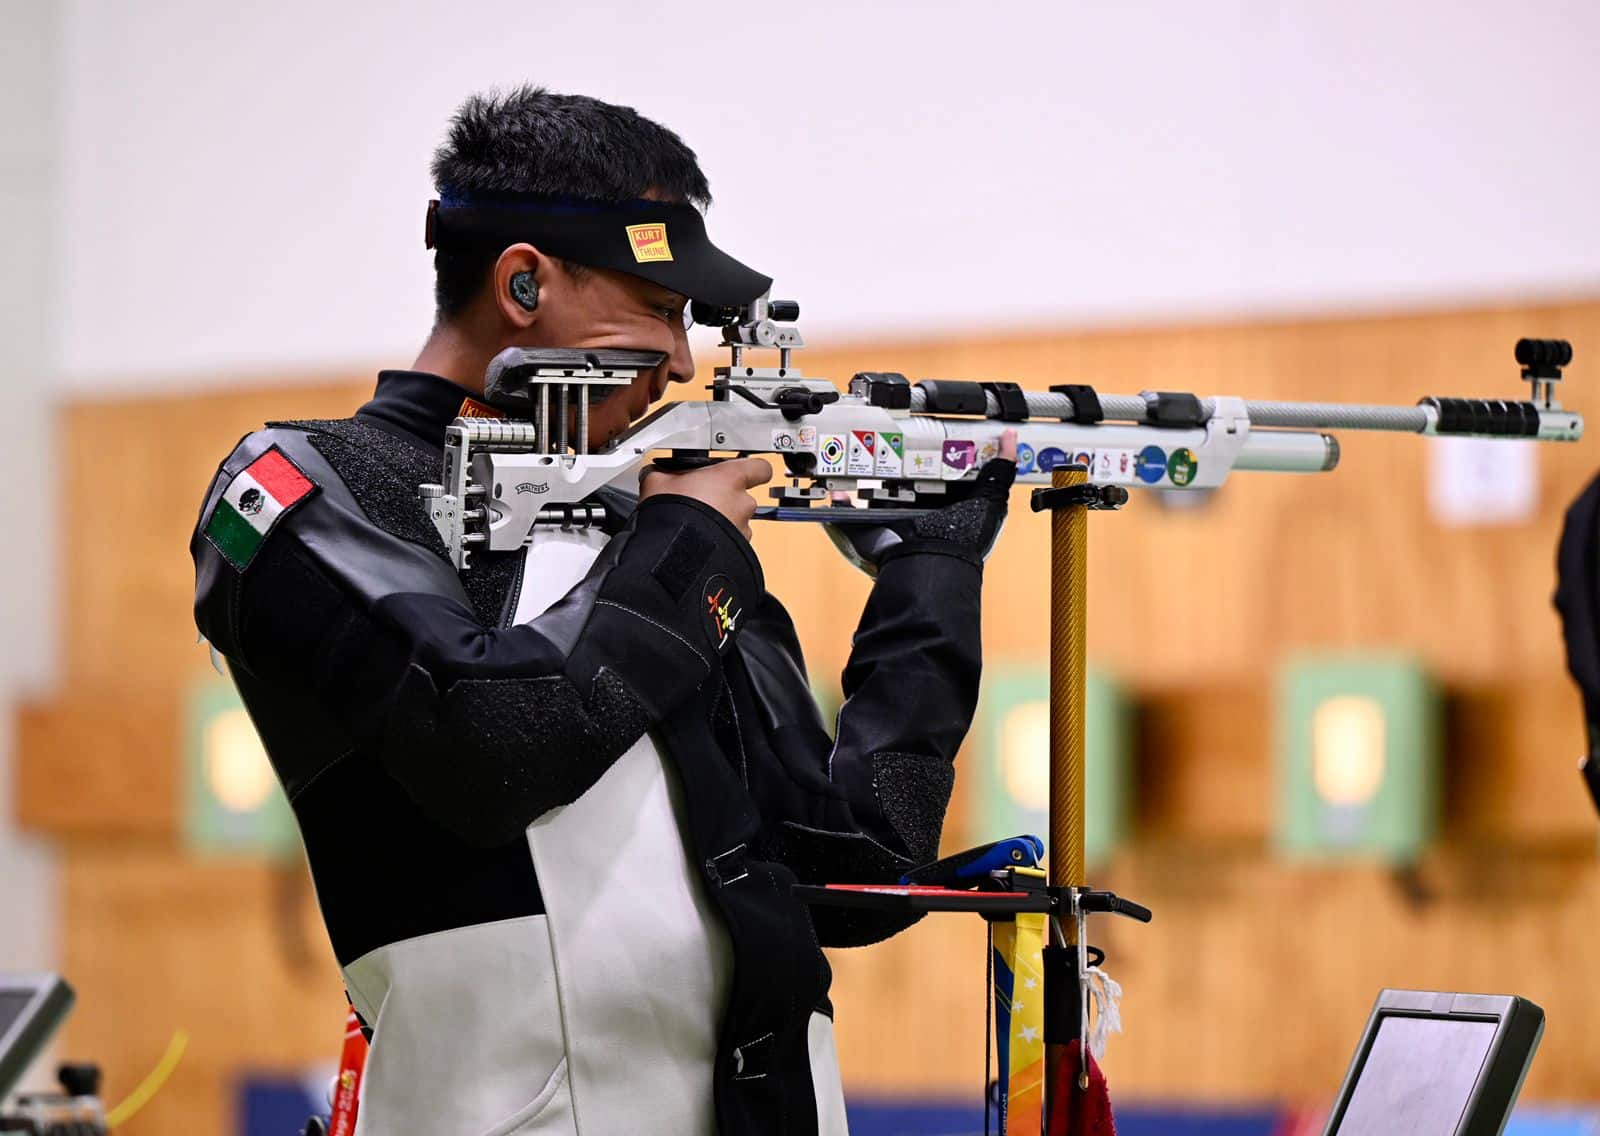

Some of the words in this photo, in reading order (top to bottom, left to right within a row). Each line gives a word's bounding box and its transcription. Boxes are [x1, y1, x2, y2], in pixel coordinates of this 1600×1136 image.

[634, 230, 661, 241] KURT
[638, 247, 666, 257] THUNE
[518, 483, 547, 493] WALTHER
